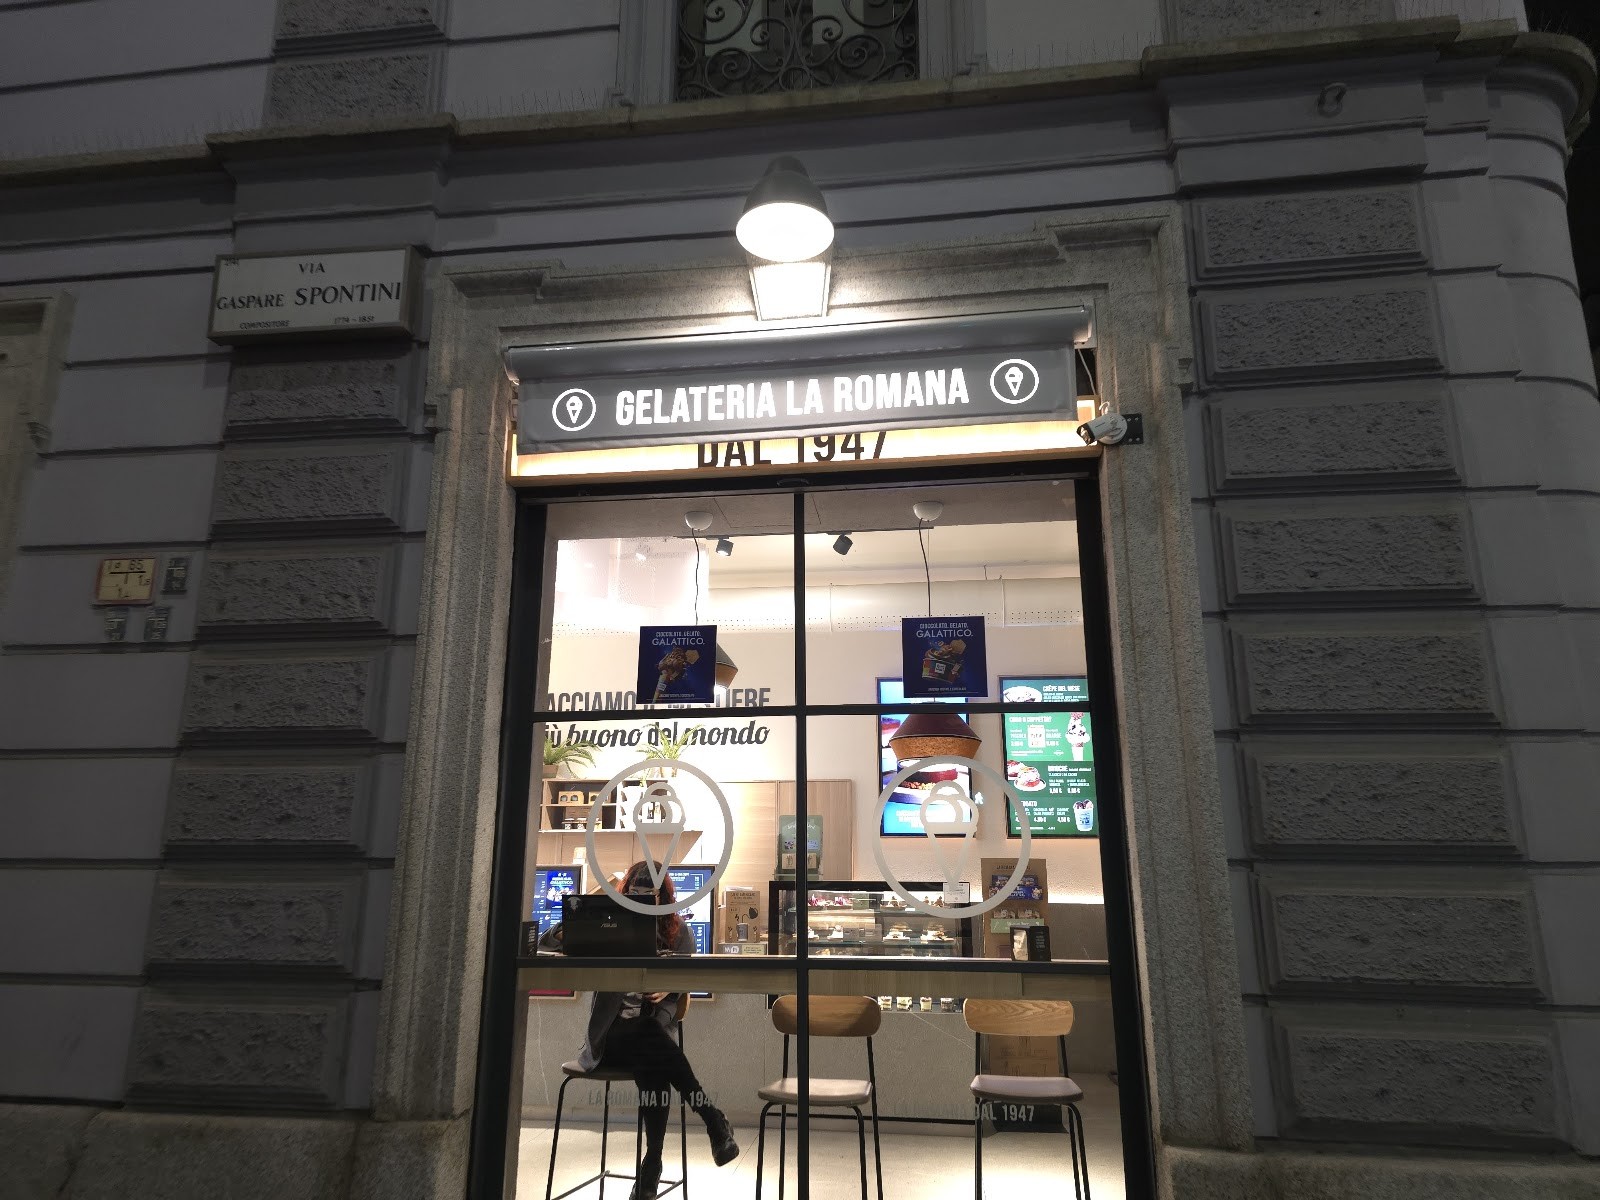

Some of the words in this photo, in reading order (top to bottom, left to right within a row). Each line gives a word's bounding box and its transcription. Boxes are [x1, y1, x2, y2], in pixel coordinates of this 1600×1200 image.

[299, 262, 325, 274] VIA
[217, 294, 284, 310] GASPARE
[294, 282, 401, 306] SPONTINI
[239, 320, 290, 330] COMPOSITORE
[615, 380, 777, 426] GELATERIA
[786, 378, 824, 416] LA
[833, 367, 970, 413] ROMANA
[699, 440, 772, 467] DAL
[566, 723, 643, 748] buono
[648, 720, 679, 746] del
[684, 720, 771, 746] mondo
[1002, 1104, 1035, 1122] 1947
